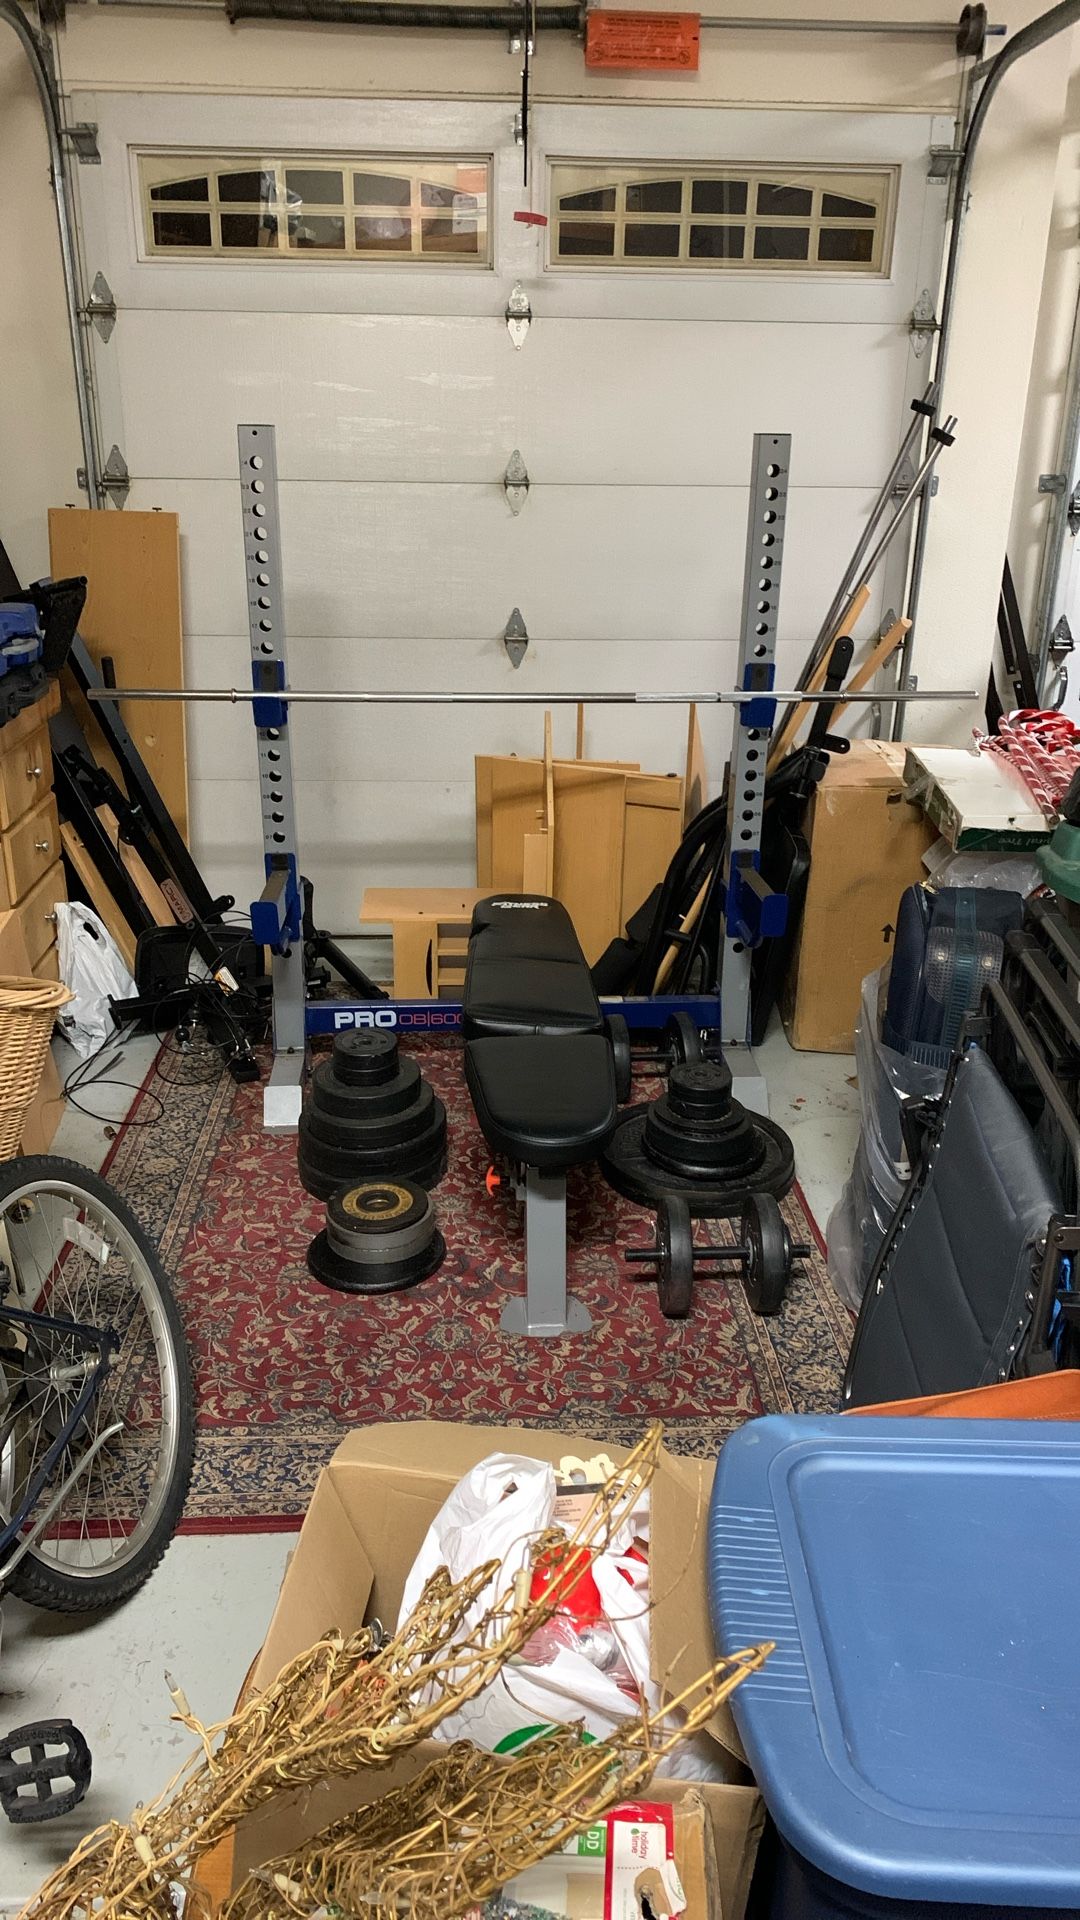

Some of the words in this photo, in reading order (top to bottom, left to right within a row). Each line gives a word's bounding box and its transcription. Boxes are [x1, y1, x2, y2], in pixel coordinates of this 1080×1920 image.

[162, 883, 184, 914] MARCY
[334, 1010, 397, 1029] PRO
[638, 1831, 648, 1859] holiday
